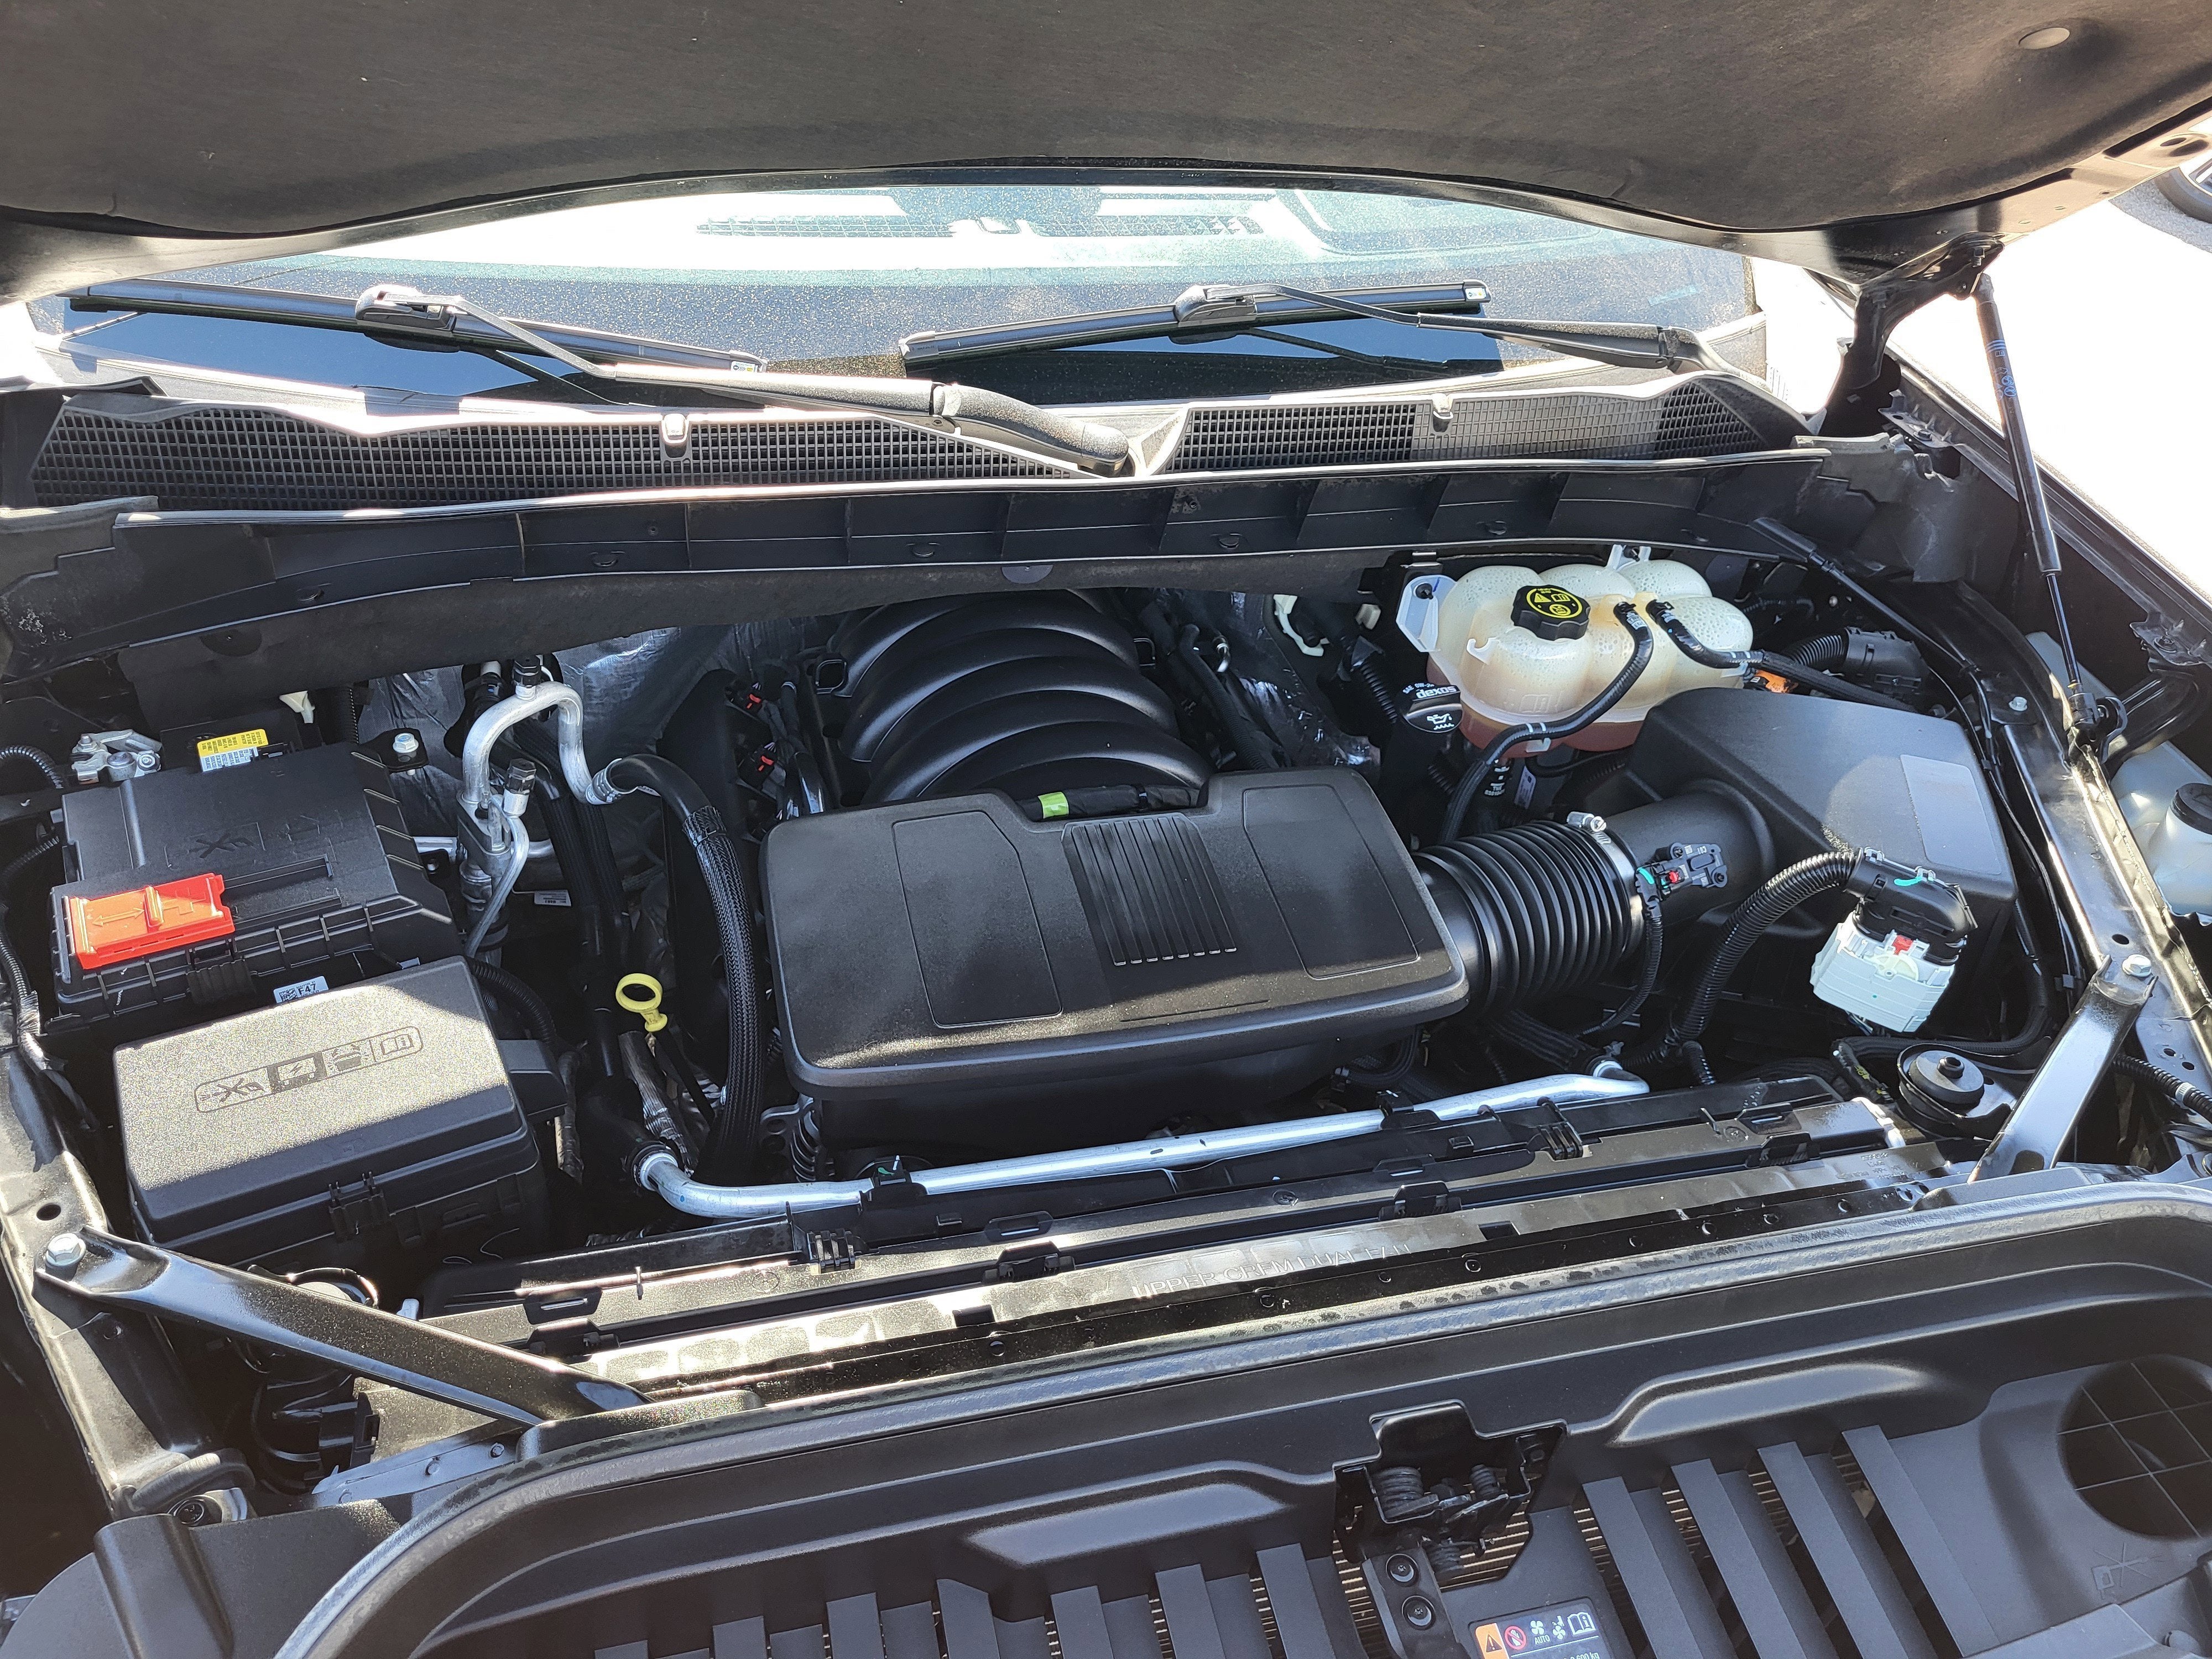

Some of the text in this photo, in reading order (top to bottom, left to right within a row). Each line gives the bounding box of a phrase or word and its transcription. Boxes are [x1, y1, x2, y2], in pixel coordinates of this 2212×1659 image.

[1416, 686, 1457, 698] dexos
[298, 983, 316, 995] F47
[1131, 1272, 1220, 1298] UPPER
[1297, 1250, 1355, 1269] DUAL
[1365, 1244, 1411, 1259] FAN
[1534, 1634, 1551, 1645] AUTO
